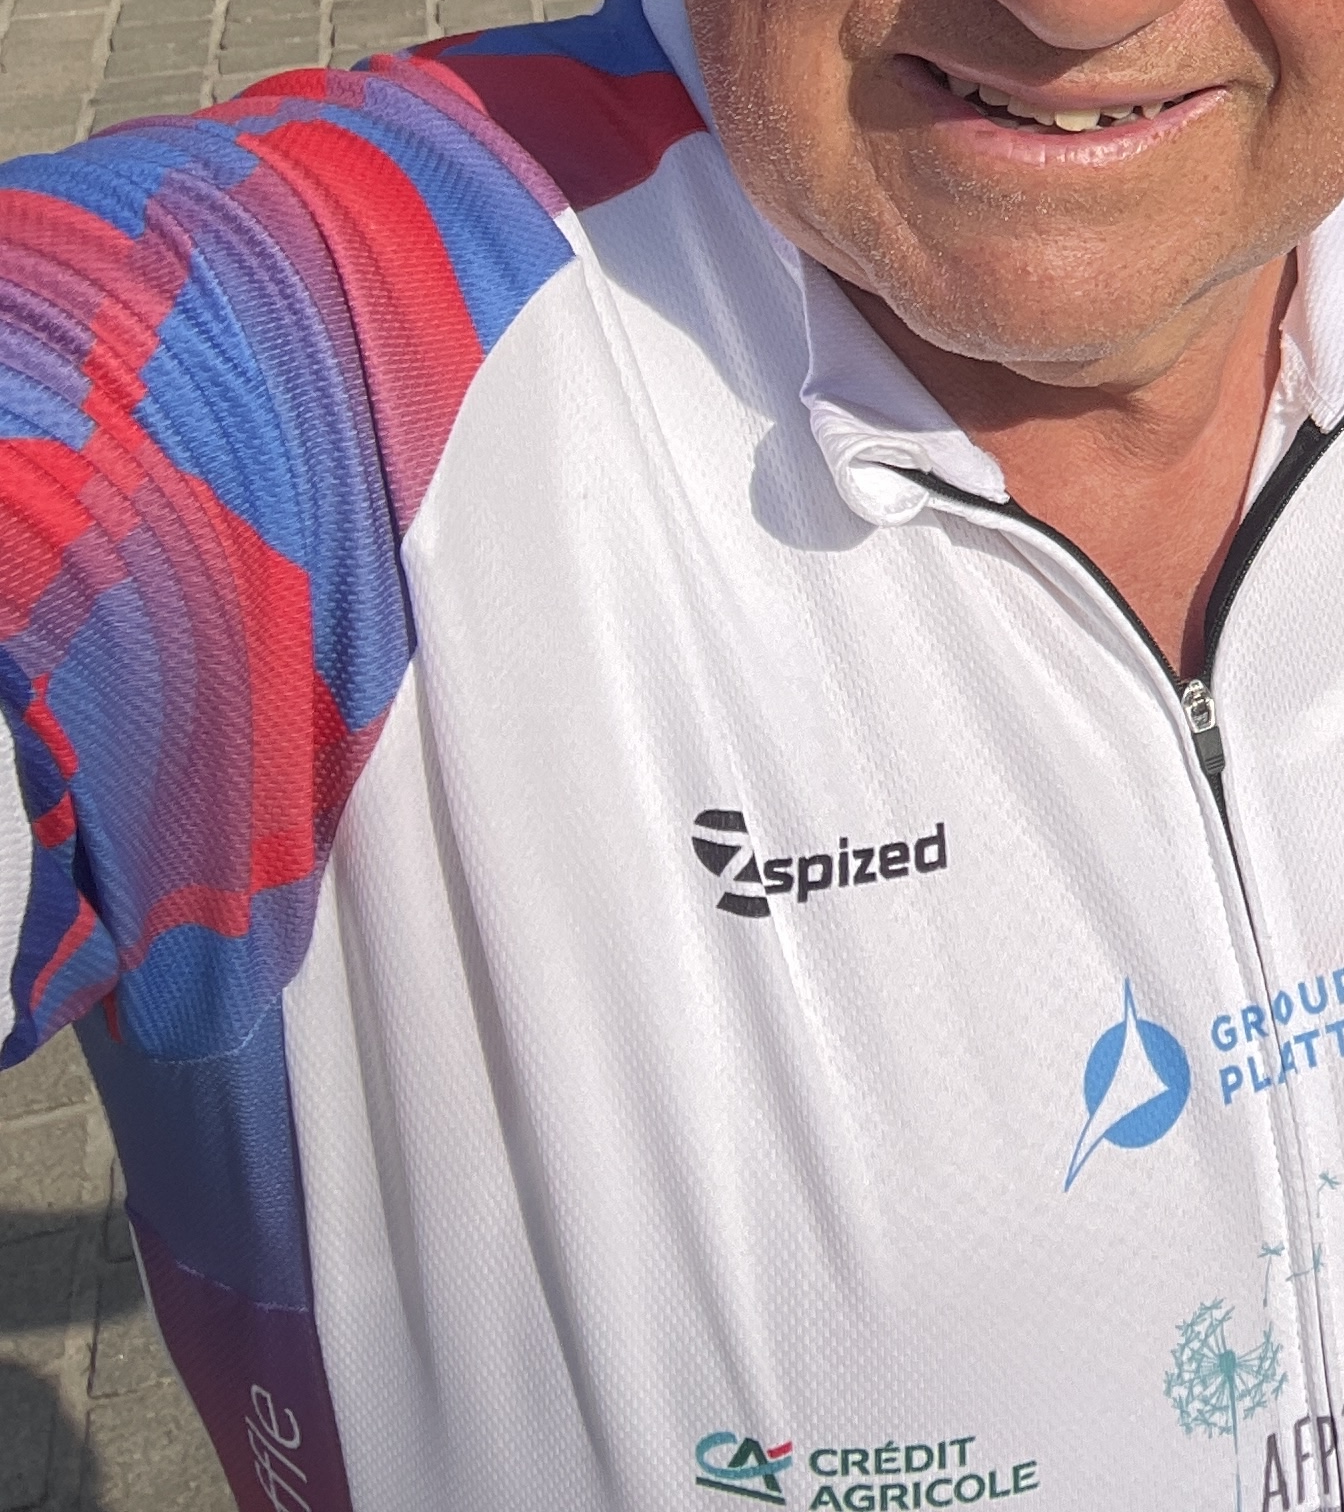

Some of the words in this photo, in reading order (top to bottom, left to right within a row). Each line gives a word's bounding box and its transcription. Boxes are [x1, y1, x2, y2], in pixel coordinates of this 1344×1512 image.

[763, 821, 948, 904] spized
[809, 1435, 977, 1477] CRÉDIT
[809, 1459, 1040, 1512] AGRICOLE
